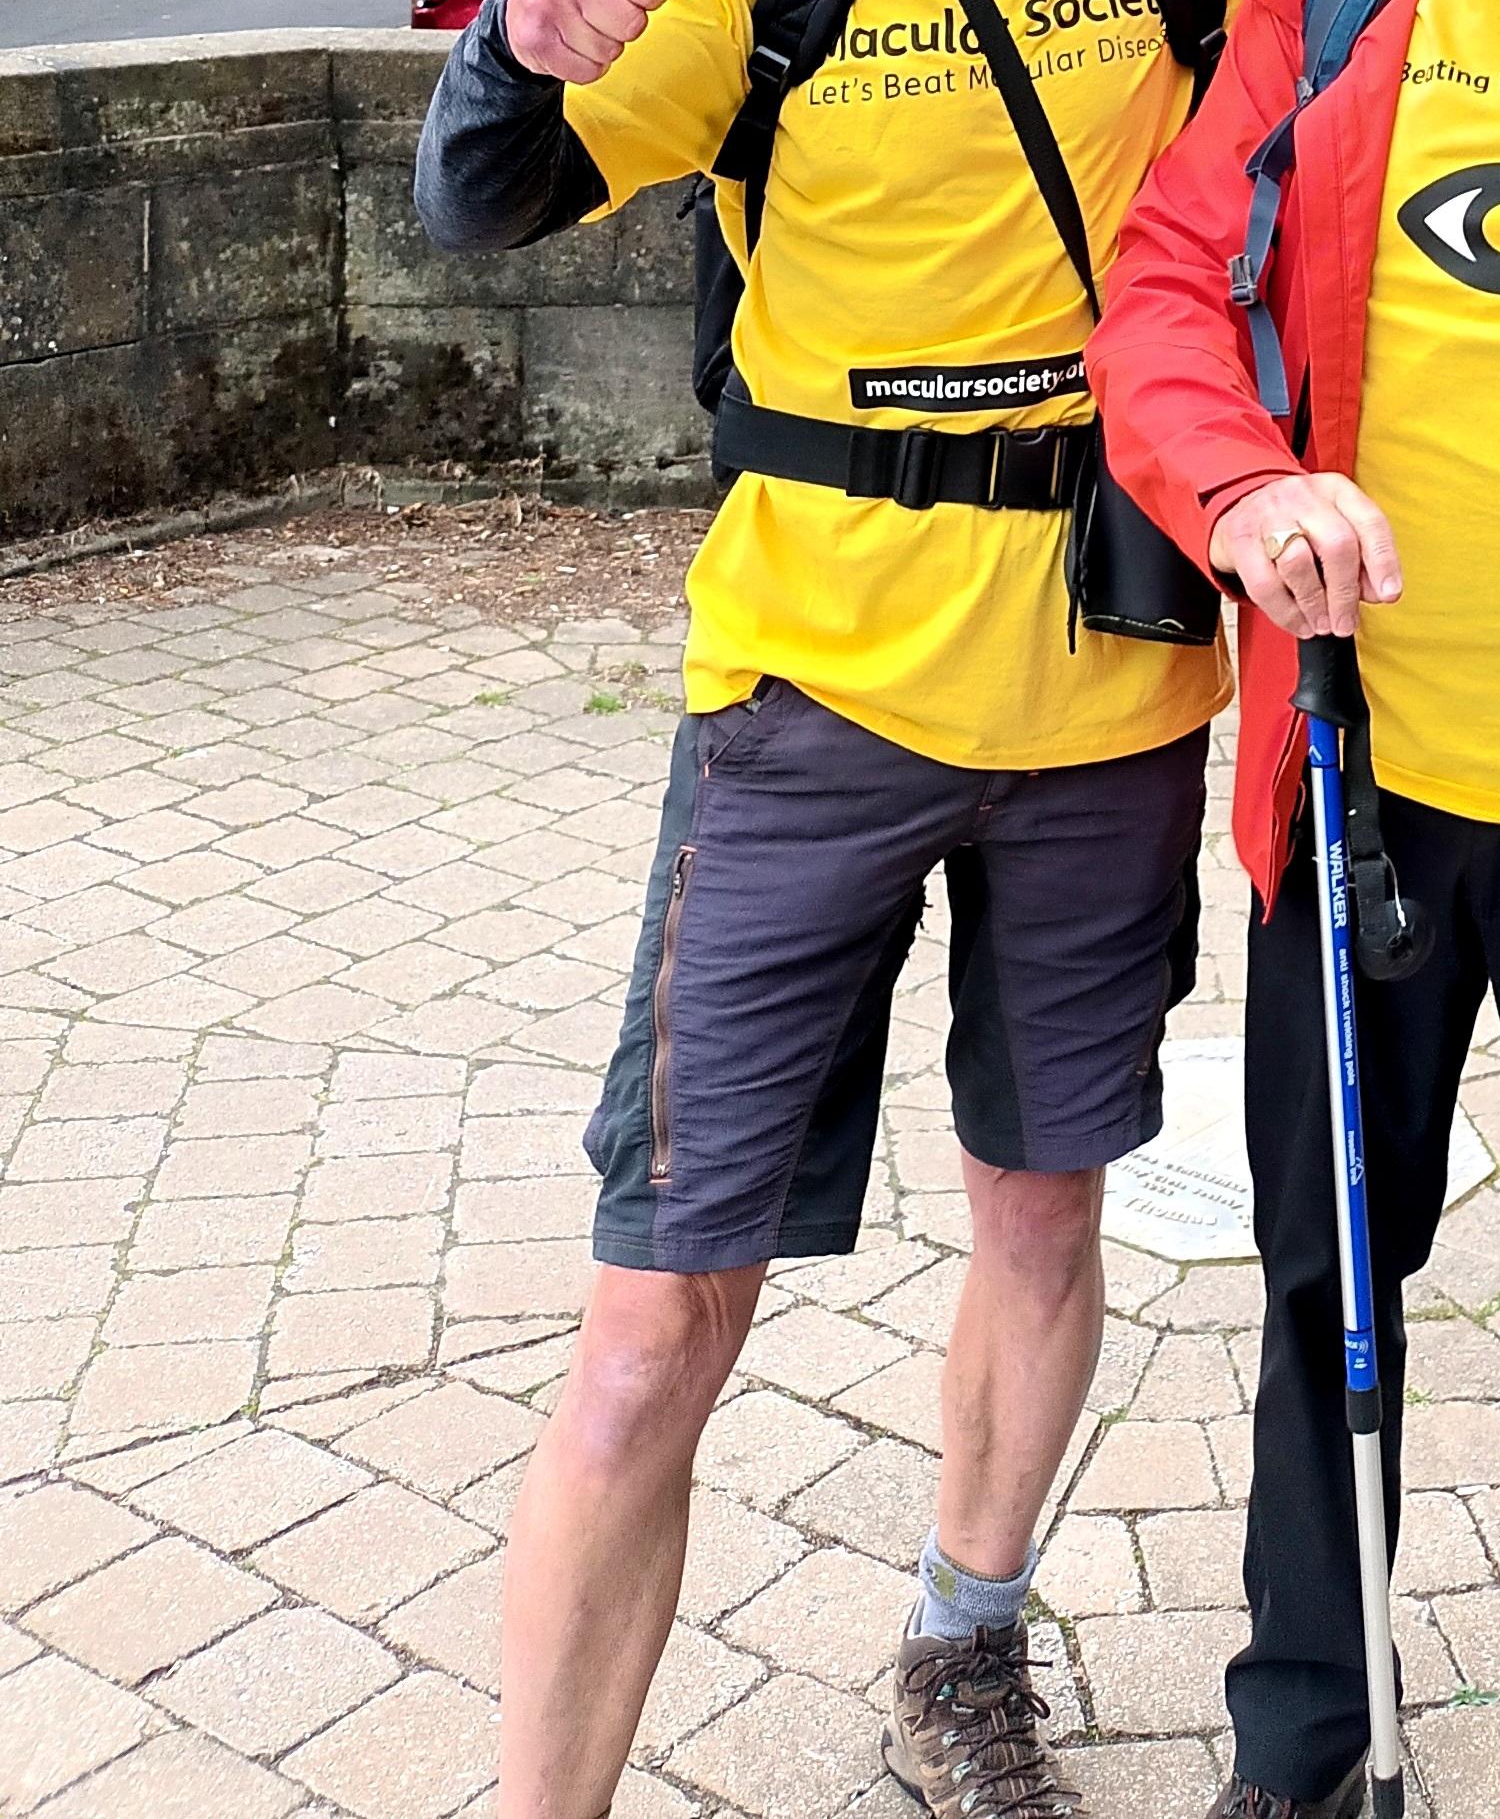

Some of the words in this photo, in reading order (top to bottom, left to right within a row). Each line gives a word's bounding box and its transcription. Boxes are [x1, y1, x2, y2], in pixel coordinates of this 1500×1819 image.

[829, 8, 1009, 61] acula
[809, 78, 873, 106] Let's
[884, 69, 957, 99] Beat
[969, 49, 1086, 90] Mular
[1329, 840, 1347, 929] WALKER
[1338, 947, 1349, 972] anti
[1340, 973, 1351, 1009] shock
